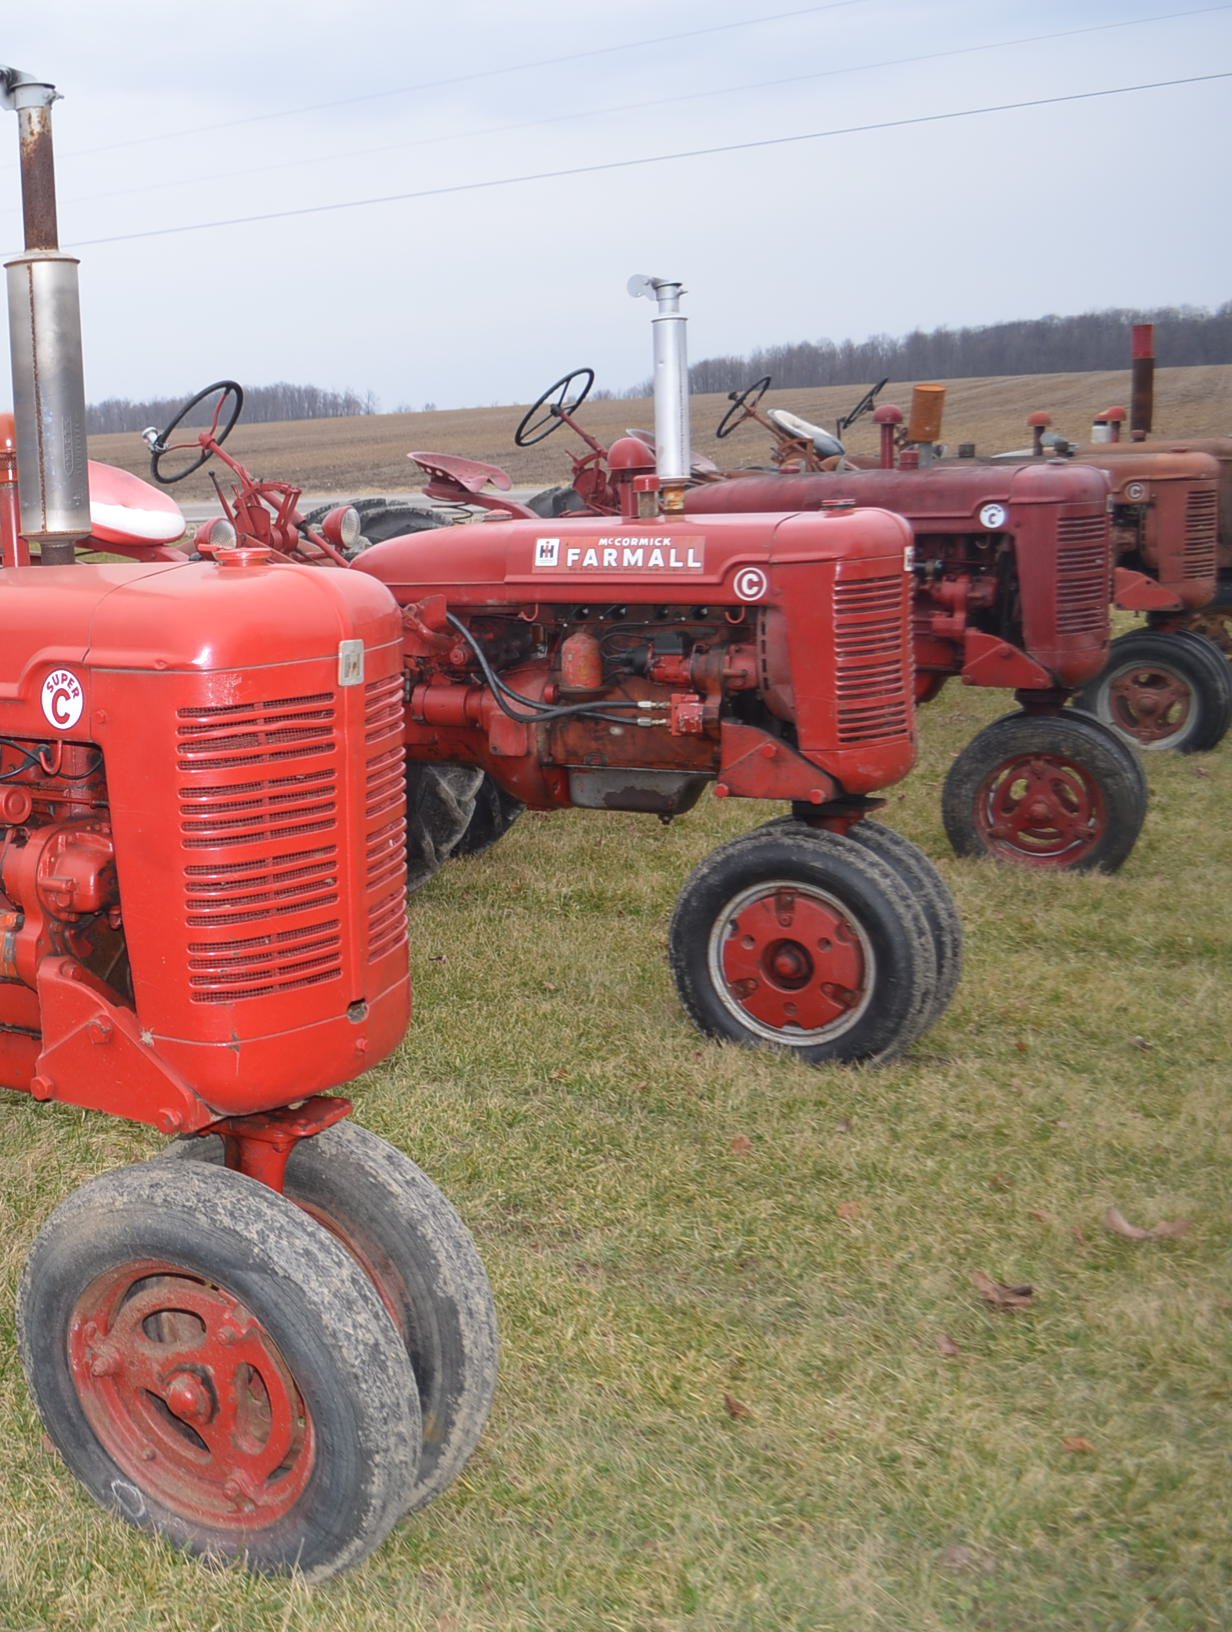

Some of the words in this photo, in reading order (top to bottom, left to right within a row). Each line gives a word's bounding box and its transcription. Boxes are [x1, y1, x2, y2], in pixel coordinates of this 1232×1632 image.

[566, 547, 702, 568] FARMALL
[741, 573, 760, 595] C
[46, 672, 81, 699] SUPER
[51, 687, 71, 725] C
